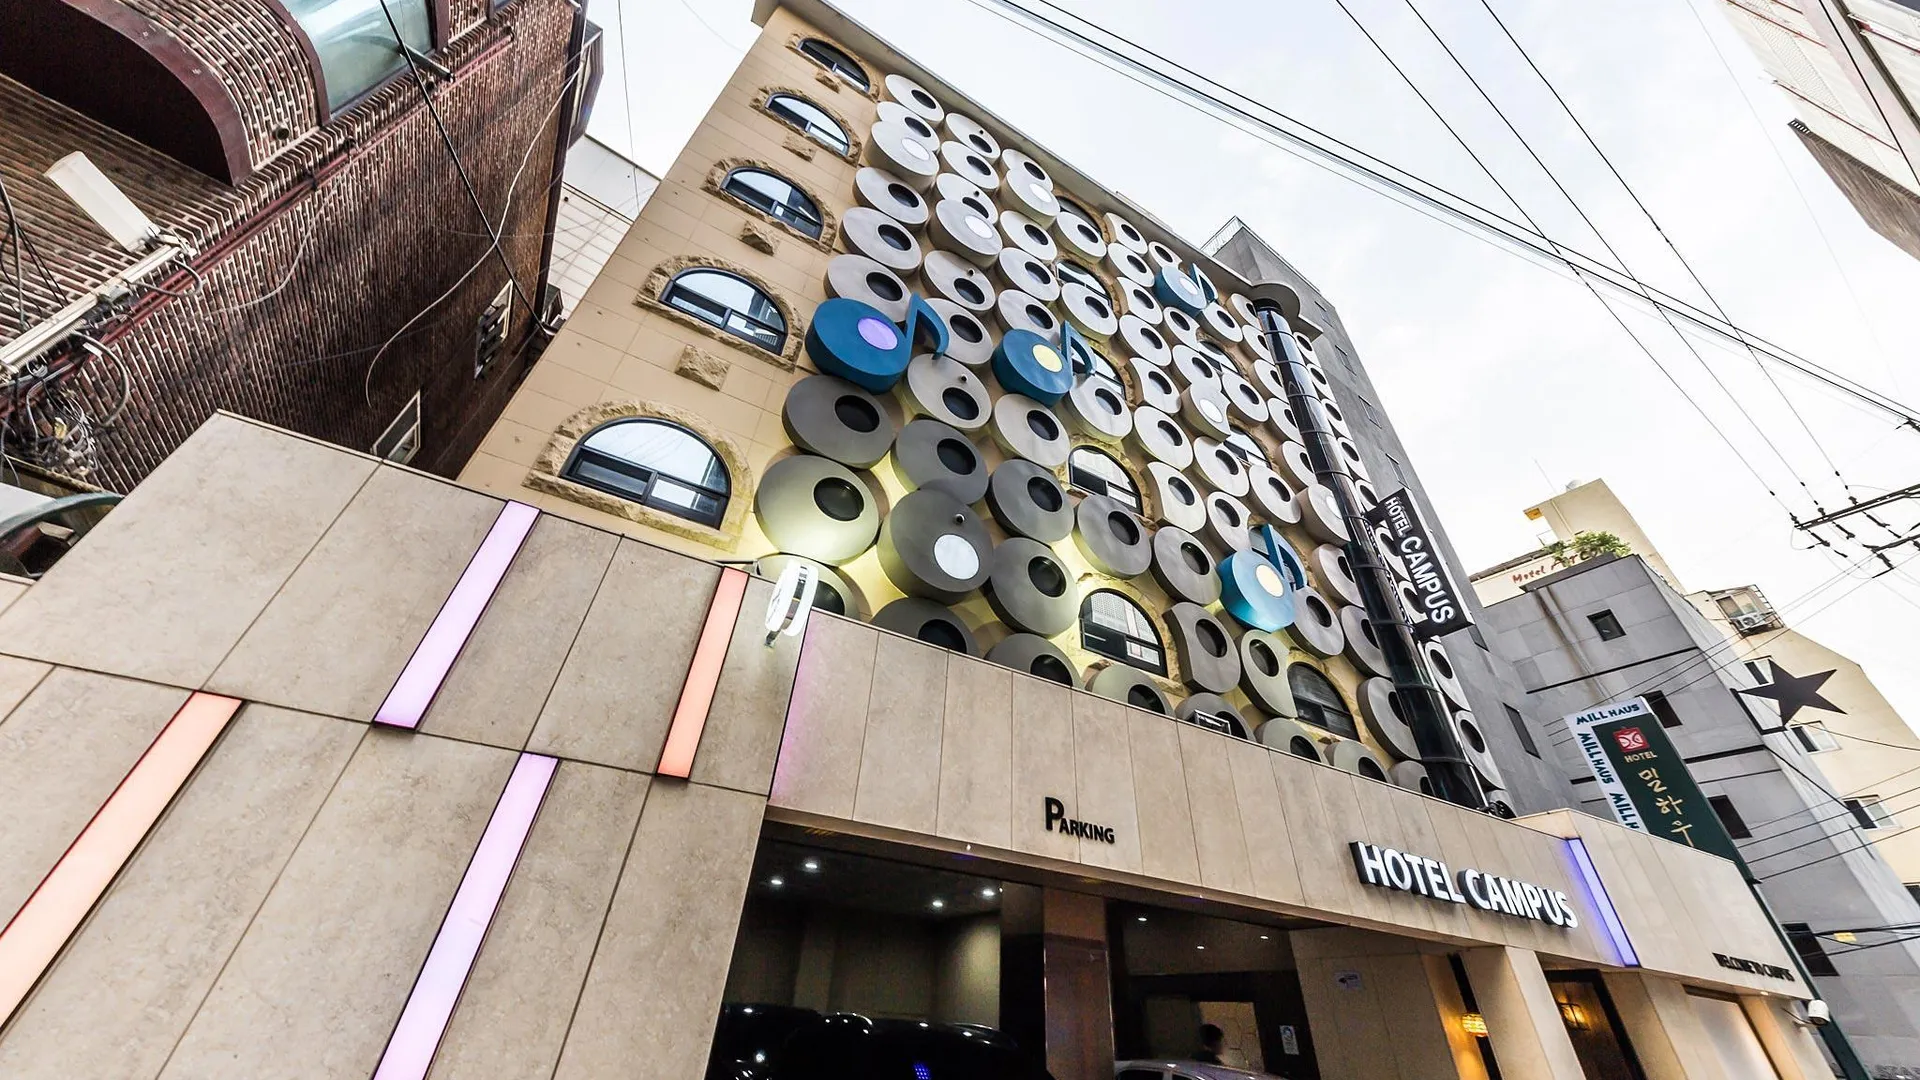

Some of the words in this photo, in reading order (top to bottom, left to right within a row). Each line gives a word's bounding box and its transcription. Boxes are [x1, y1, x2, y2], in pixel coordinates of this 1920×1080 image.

[1385, 496, 1412, 537] HOTEL
[1401, 536, 1456, 623] CAMPUS
[1576, 711, 1607, 725] MILL
[1608, 704, 1640, 717] HAUS
[1577, 733, 1602, 759] MILL
[1592, 759, 1615, 784] HAUS
[1624, 751, 1657, 763] HOTEL
[1609, 792, 1636, 822] MILL
[1352, 841, 1466, 904] HOTEL
[1458, 868, 1578, 928] CAMPUS
